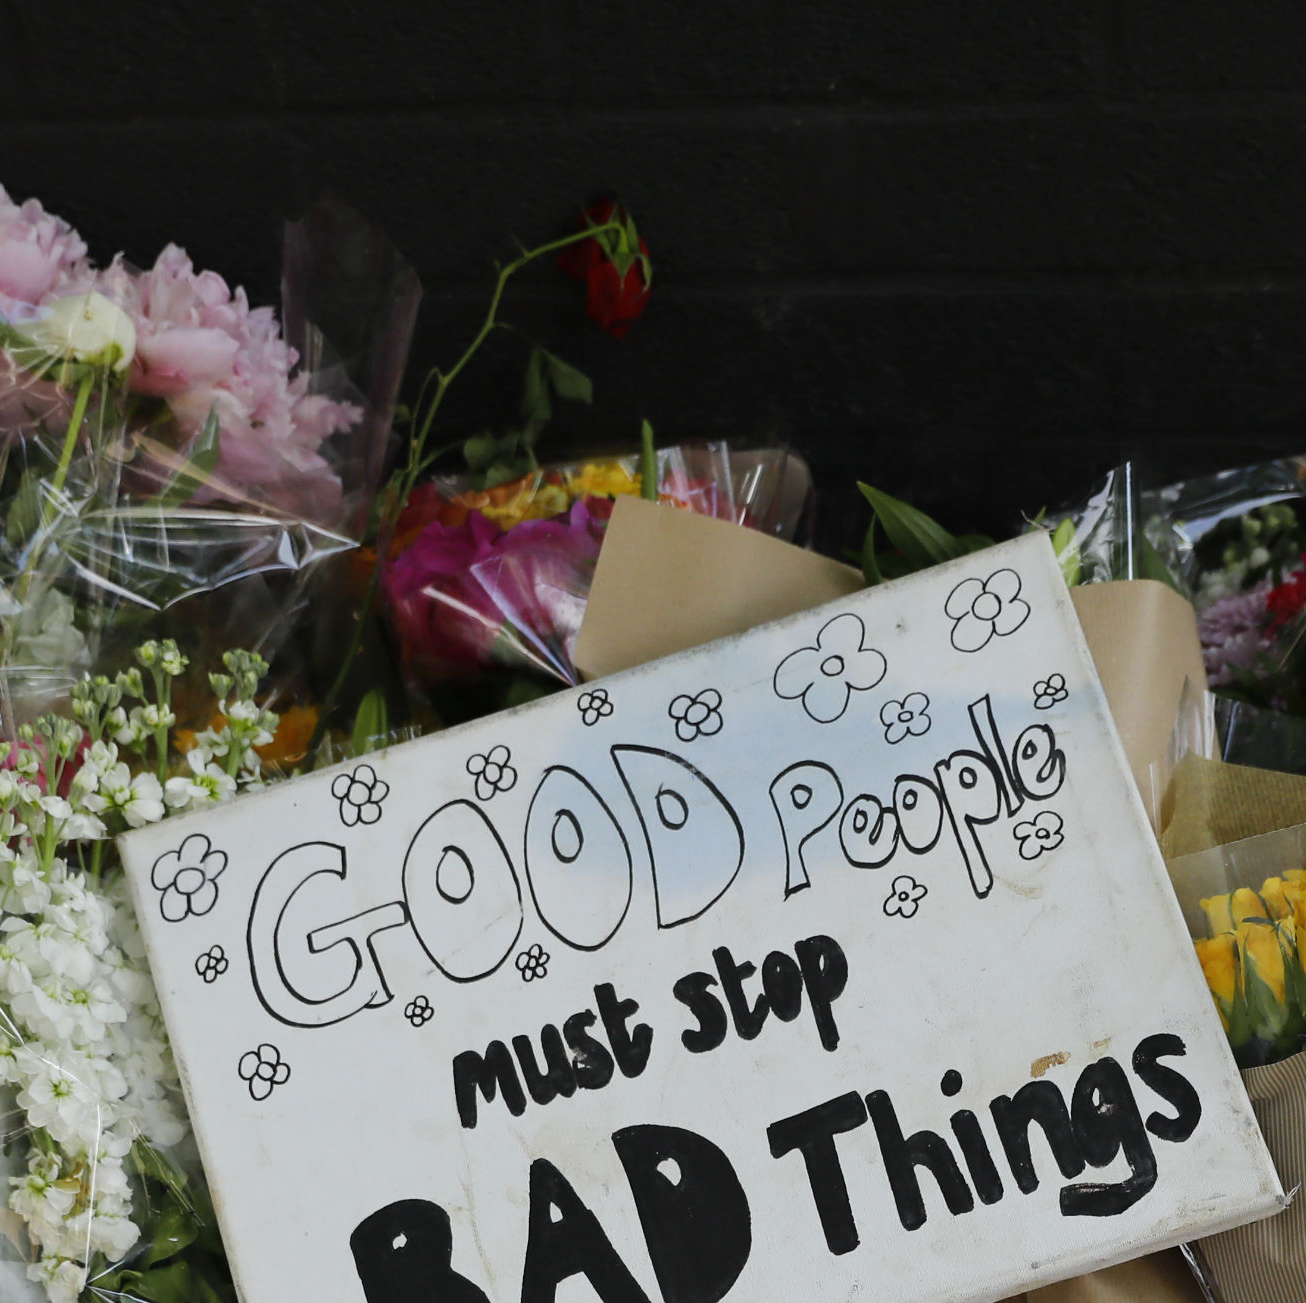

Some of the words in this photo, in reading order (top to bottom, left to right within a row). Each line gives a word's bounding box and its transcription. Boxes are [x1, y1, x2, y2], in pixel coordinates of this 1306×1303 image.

[246, 743, 746, 1028] GOOD
[767, 694, 1067, 899] People
[453, 982, 653, 1129] must
[681, 935, 849, 1052] stop
[766, 1032, 1201, 1256] Things
